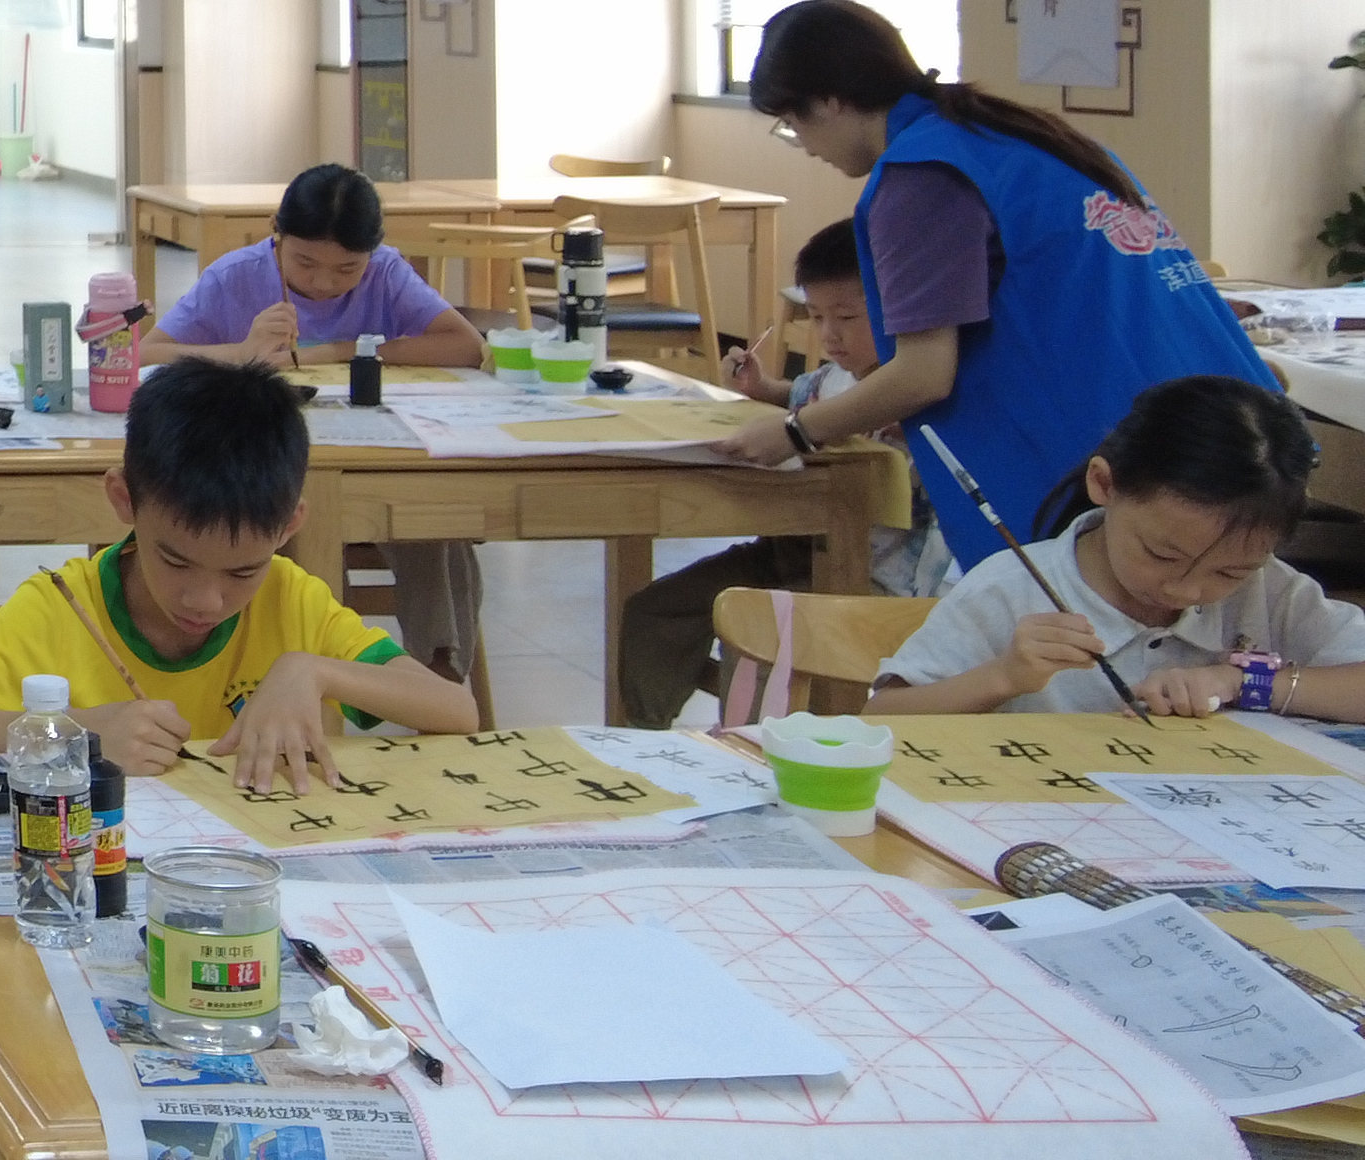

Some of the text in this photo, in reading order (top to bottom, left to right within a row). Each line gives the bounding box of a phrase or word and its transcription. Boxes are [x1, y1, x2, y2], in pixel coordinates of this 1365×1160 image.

[894, 739, 944, 763] 中
[990, 739, 1052, 765] 中
[1105, 737, 1155, 765] 中
[1199, 742, 1263, 766] 中
[930, 766, 996, 791] 中
[386, 803, 433, 822] 中
[485, 791, 540, 813] 中
[290, 808, 337, 832] 中
[200, 945, 254, 959] 康美中药
[201, 963, 255, 984] 菊花
[156, 1103, 414, 1125] 近距离探秘垃圾“变废为宝
